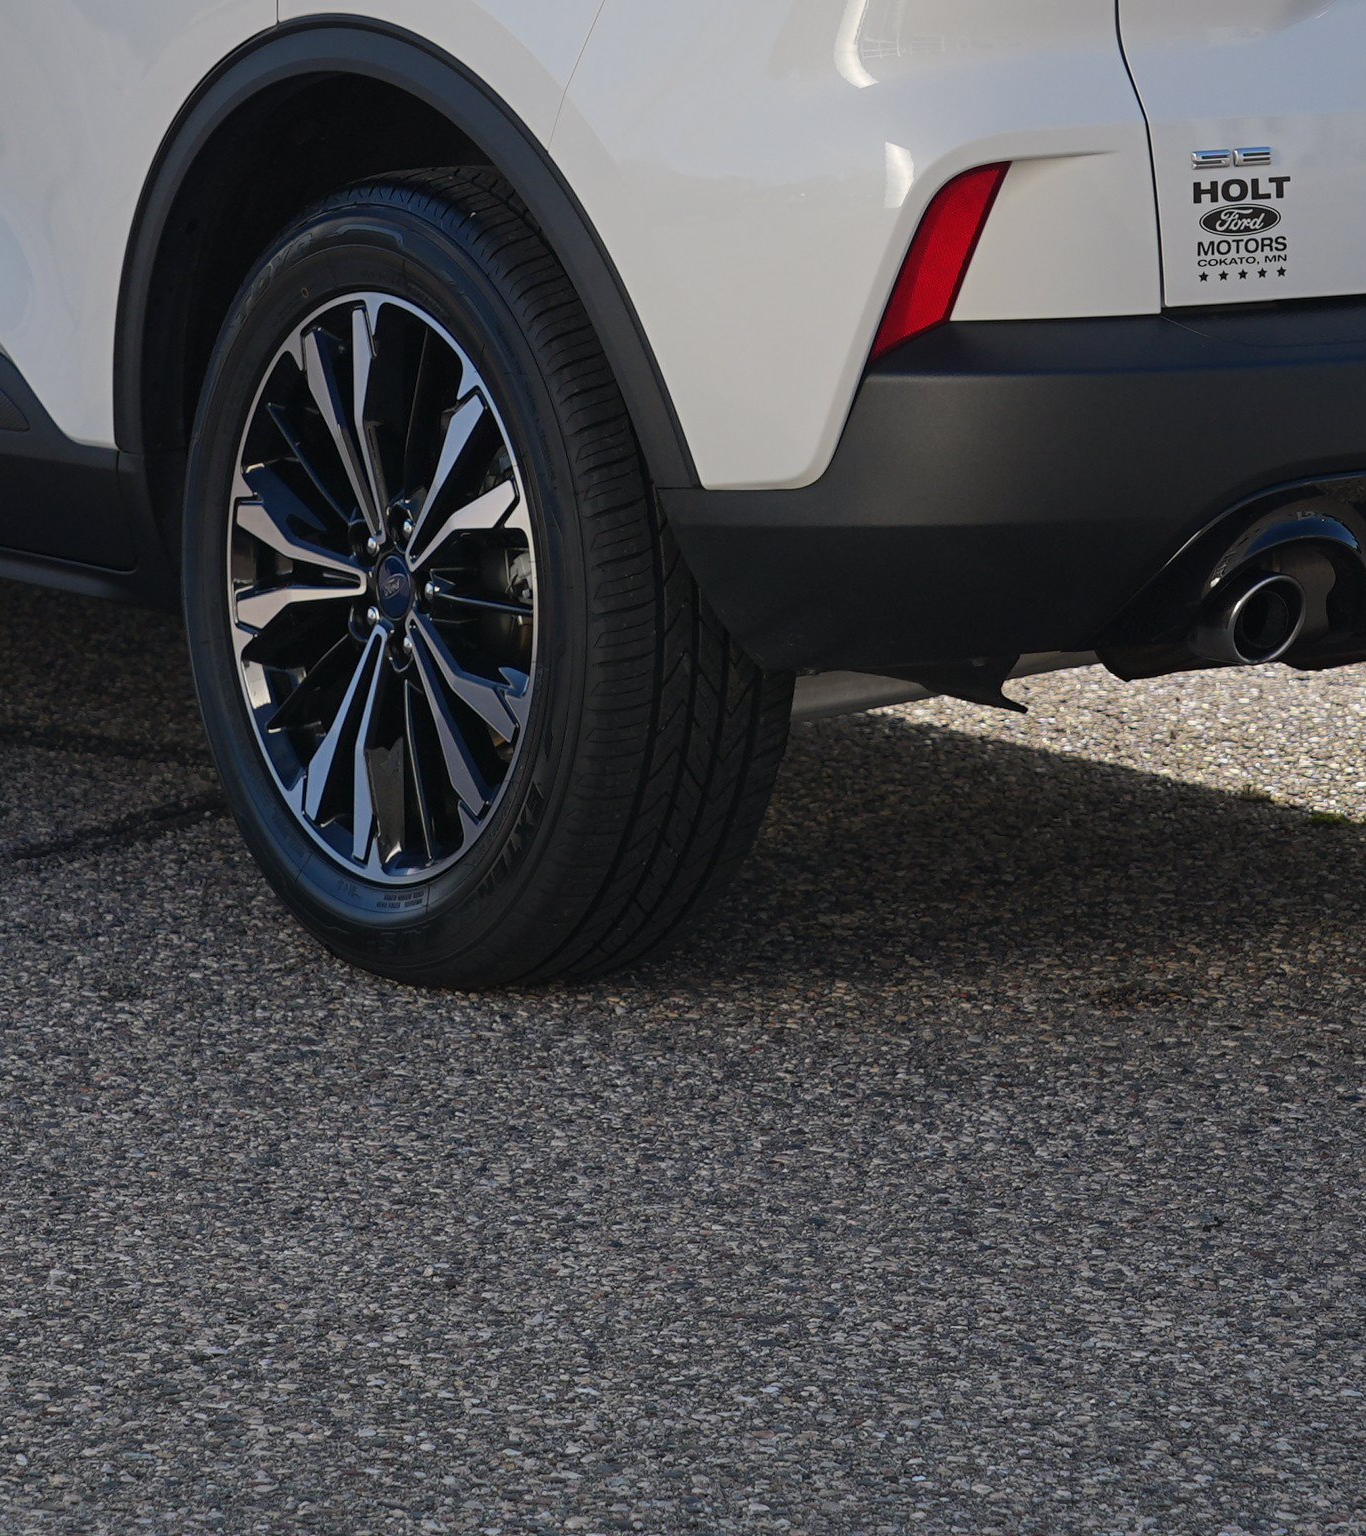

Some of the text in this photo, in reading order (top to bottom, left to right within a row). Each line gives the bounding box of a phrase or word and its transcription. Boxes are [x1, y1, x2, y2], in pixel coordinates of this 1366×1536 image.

[1191, 146, 1272, 170] SE
[1193, 176, 1291, 204] HOLT
[1215, 208, 1265, 231] Ford
[1197, 236, 1287, 257] MOTORS
[1197, 254, 1287, 267] COKATO, MN
